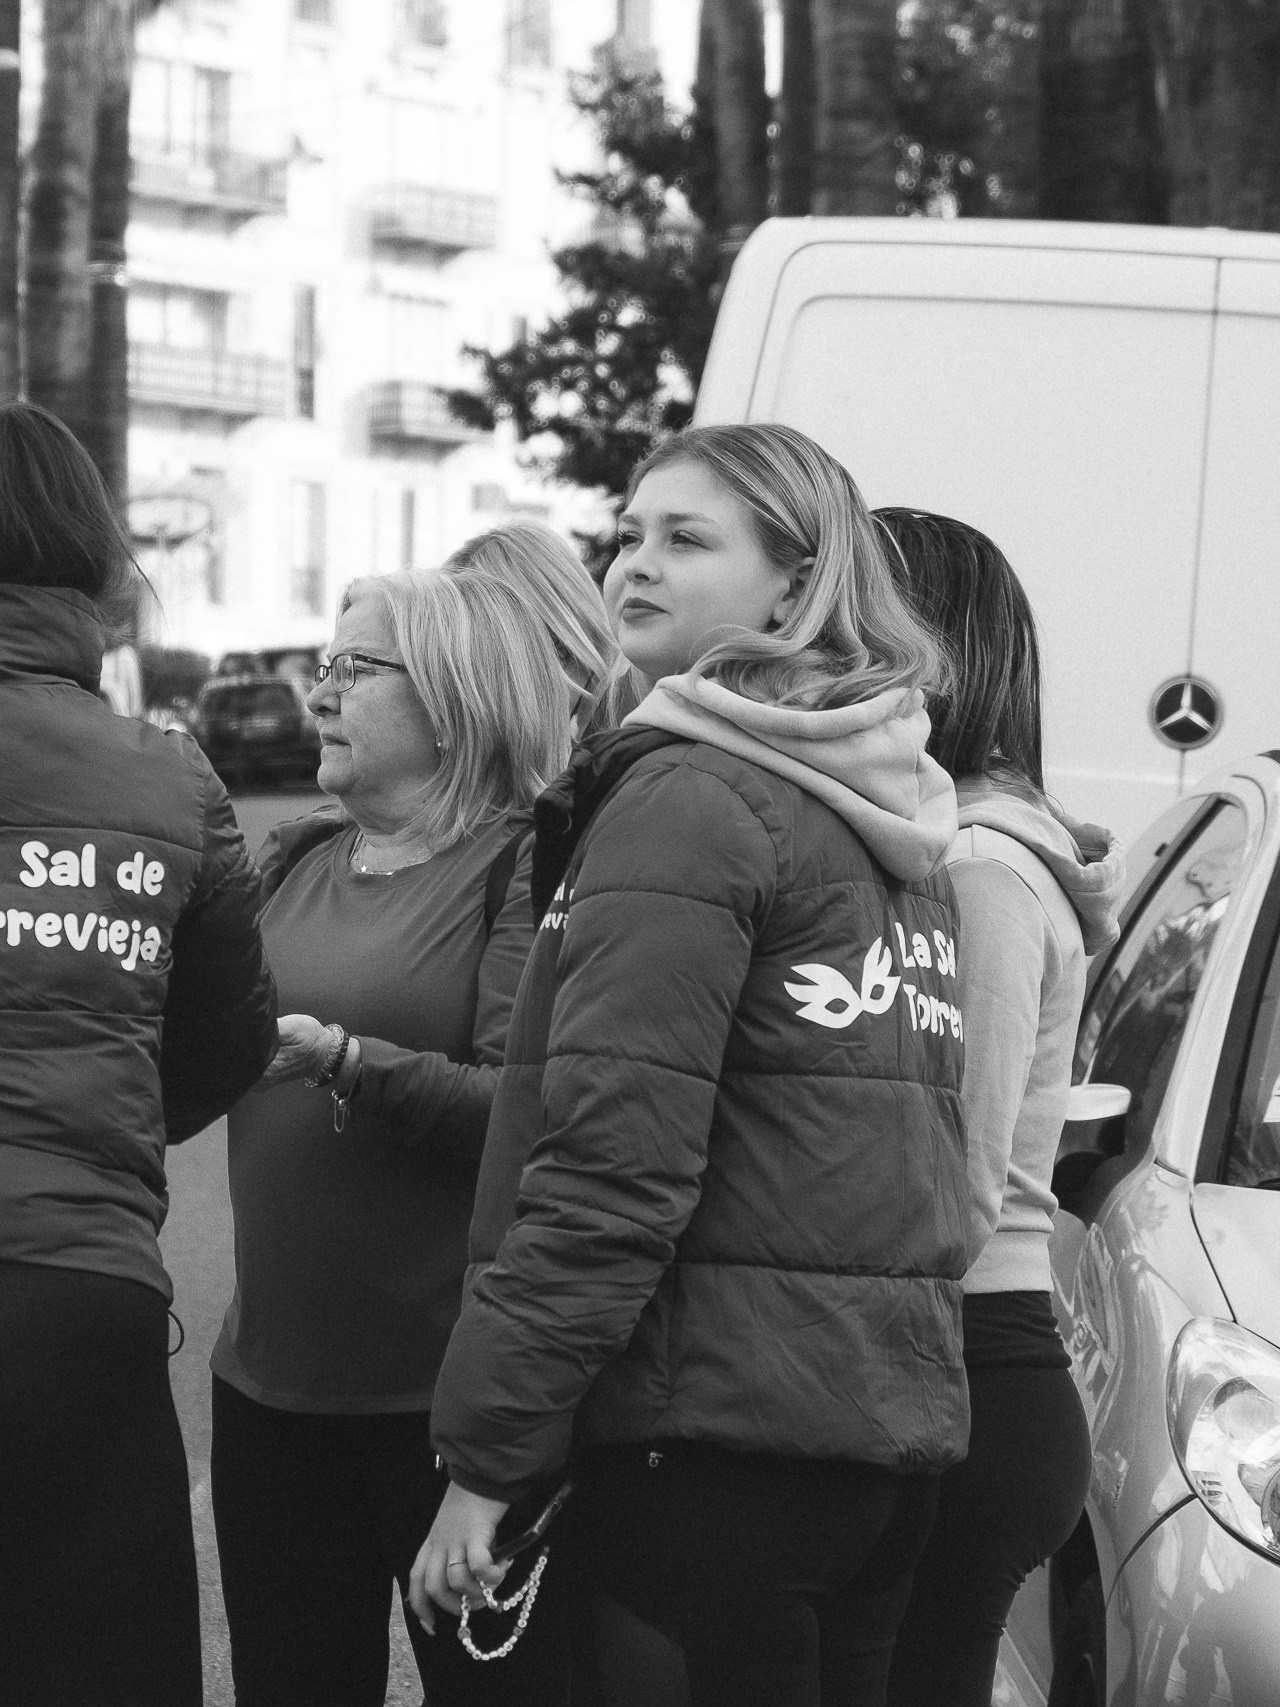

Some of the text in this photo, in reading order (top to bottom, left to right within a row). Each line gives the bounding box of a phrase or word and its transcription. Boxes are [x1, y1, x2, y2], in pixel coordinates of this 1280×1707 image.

[19, 840, 96, 888] Sal
[116, 851, 165, 896] de
[894, 921, 933, 968] La
